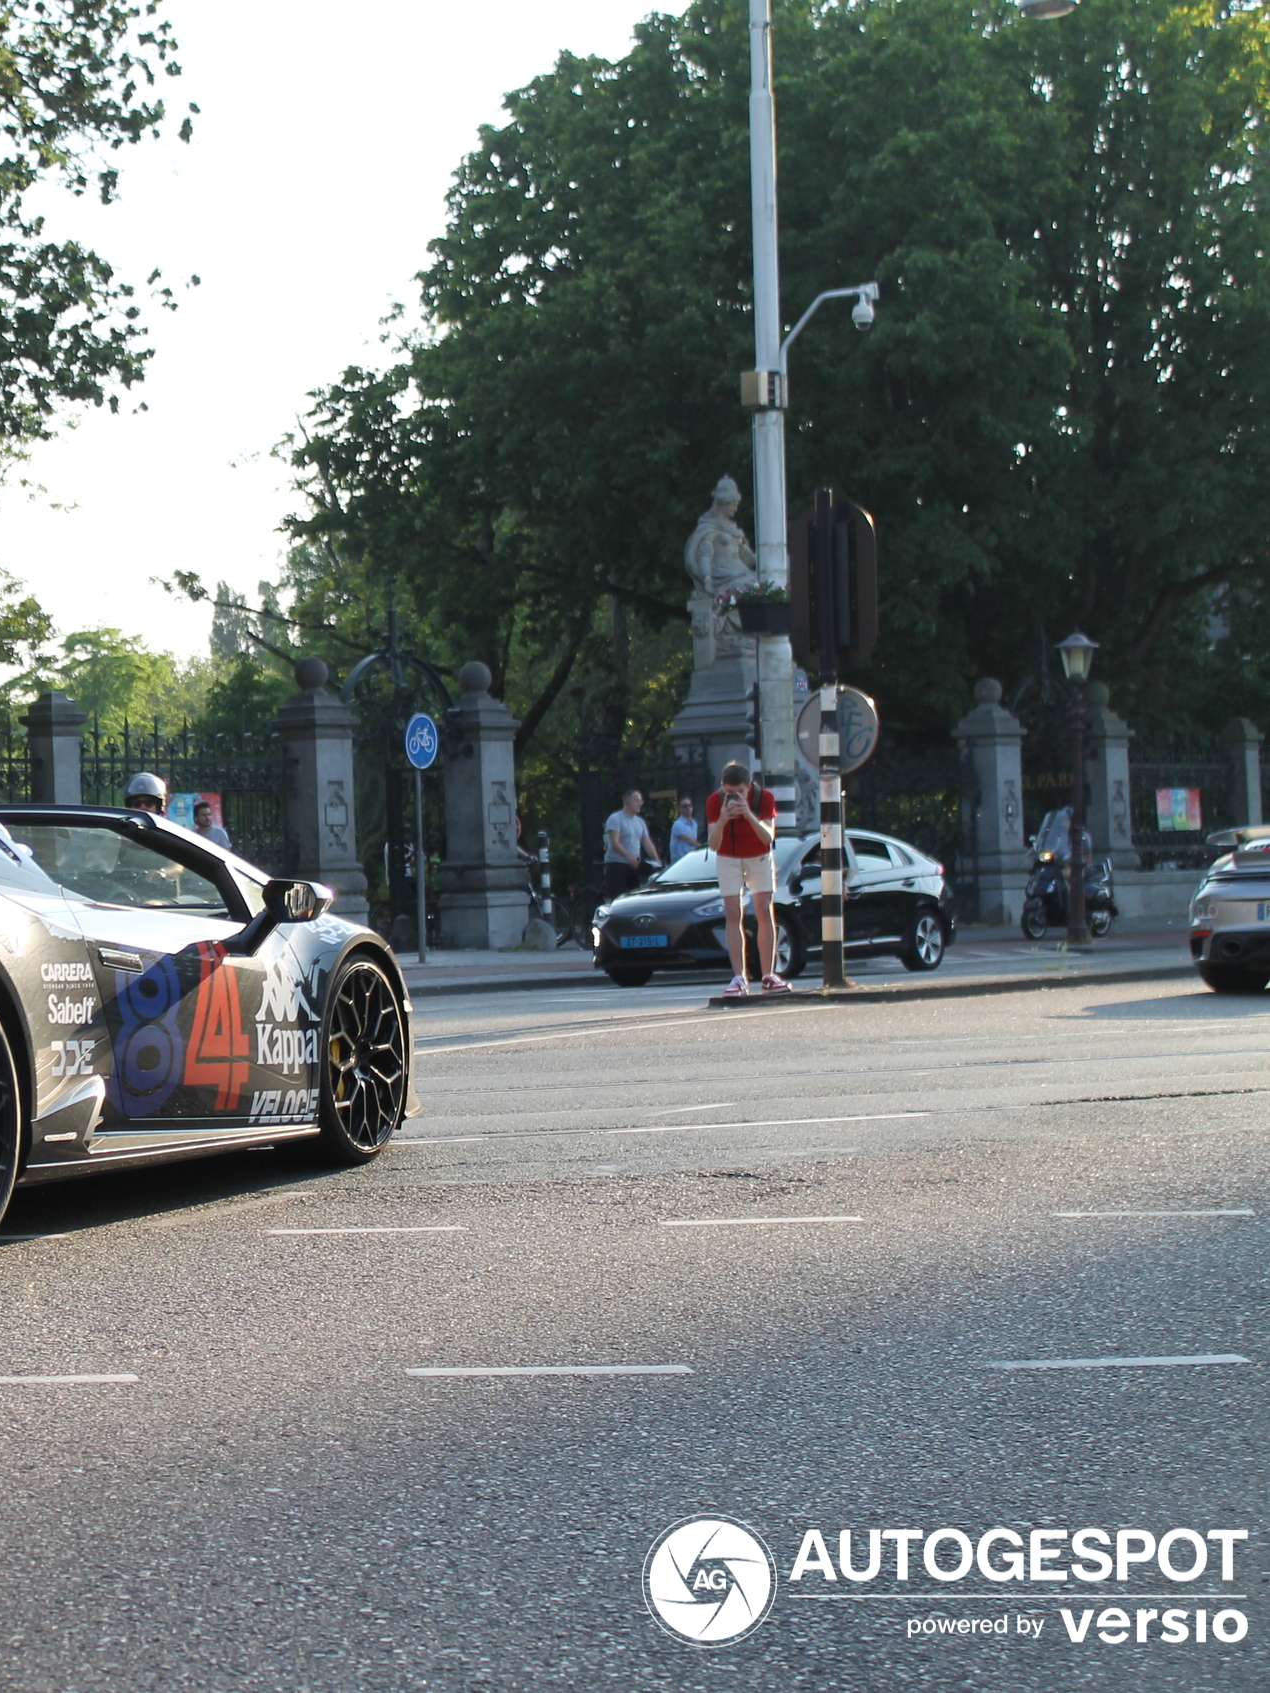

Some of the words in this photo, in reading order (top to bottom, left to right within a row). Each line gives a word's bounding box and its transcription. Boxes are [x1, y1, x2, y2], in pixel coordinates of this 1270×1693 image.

[41, 963, 93, 982] CARRERA
[48, 993, 93, 1024] Sabelt
[255, 1023, 319, 1075] Kappa
[248, 1088, 320, 1124] VELOCE
